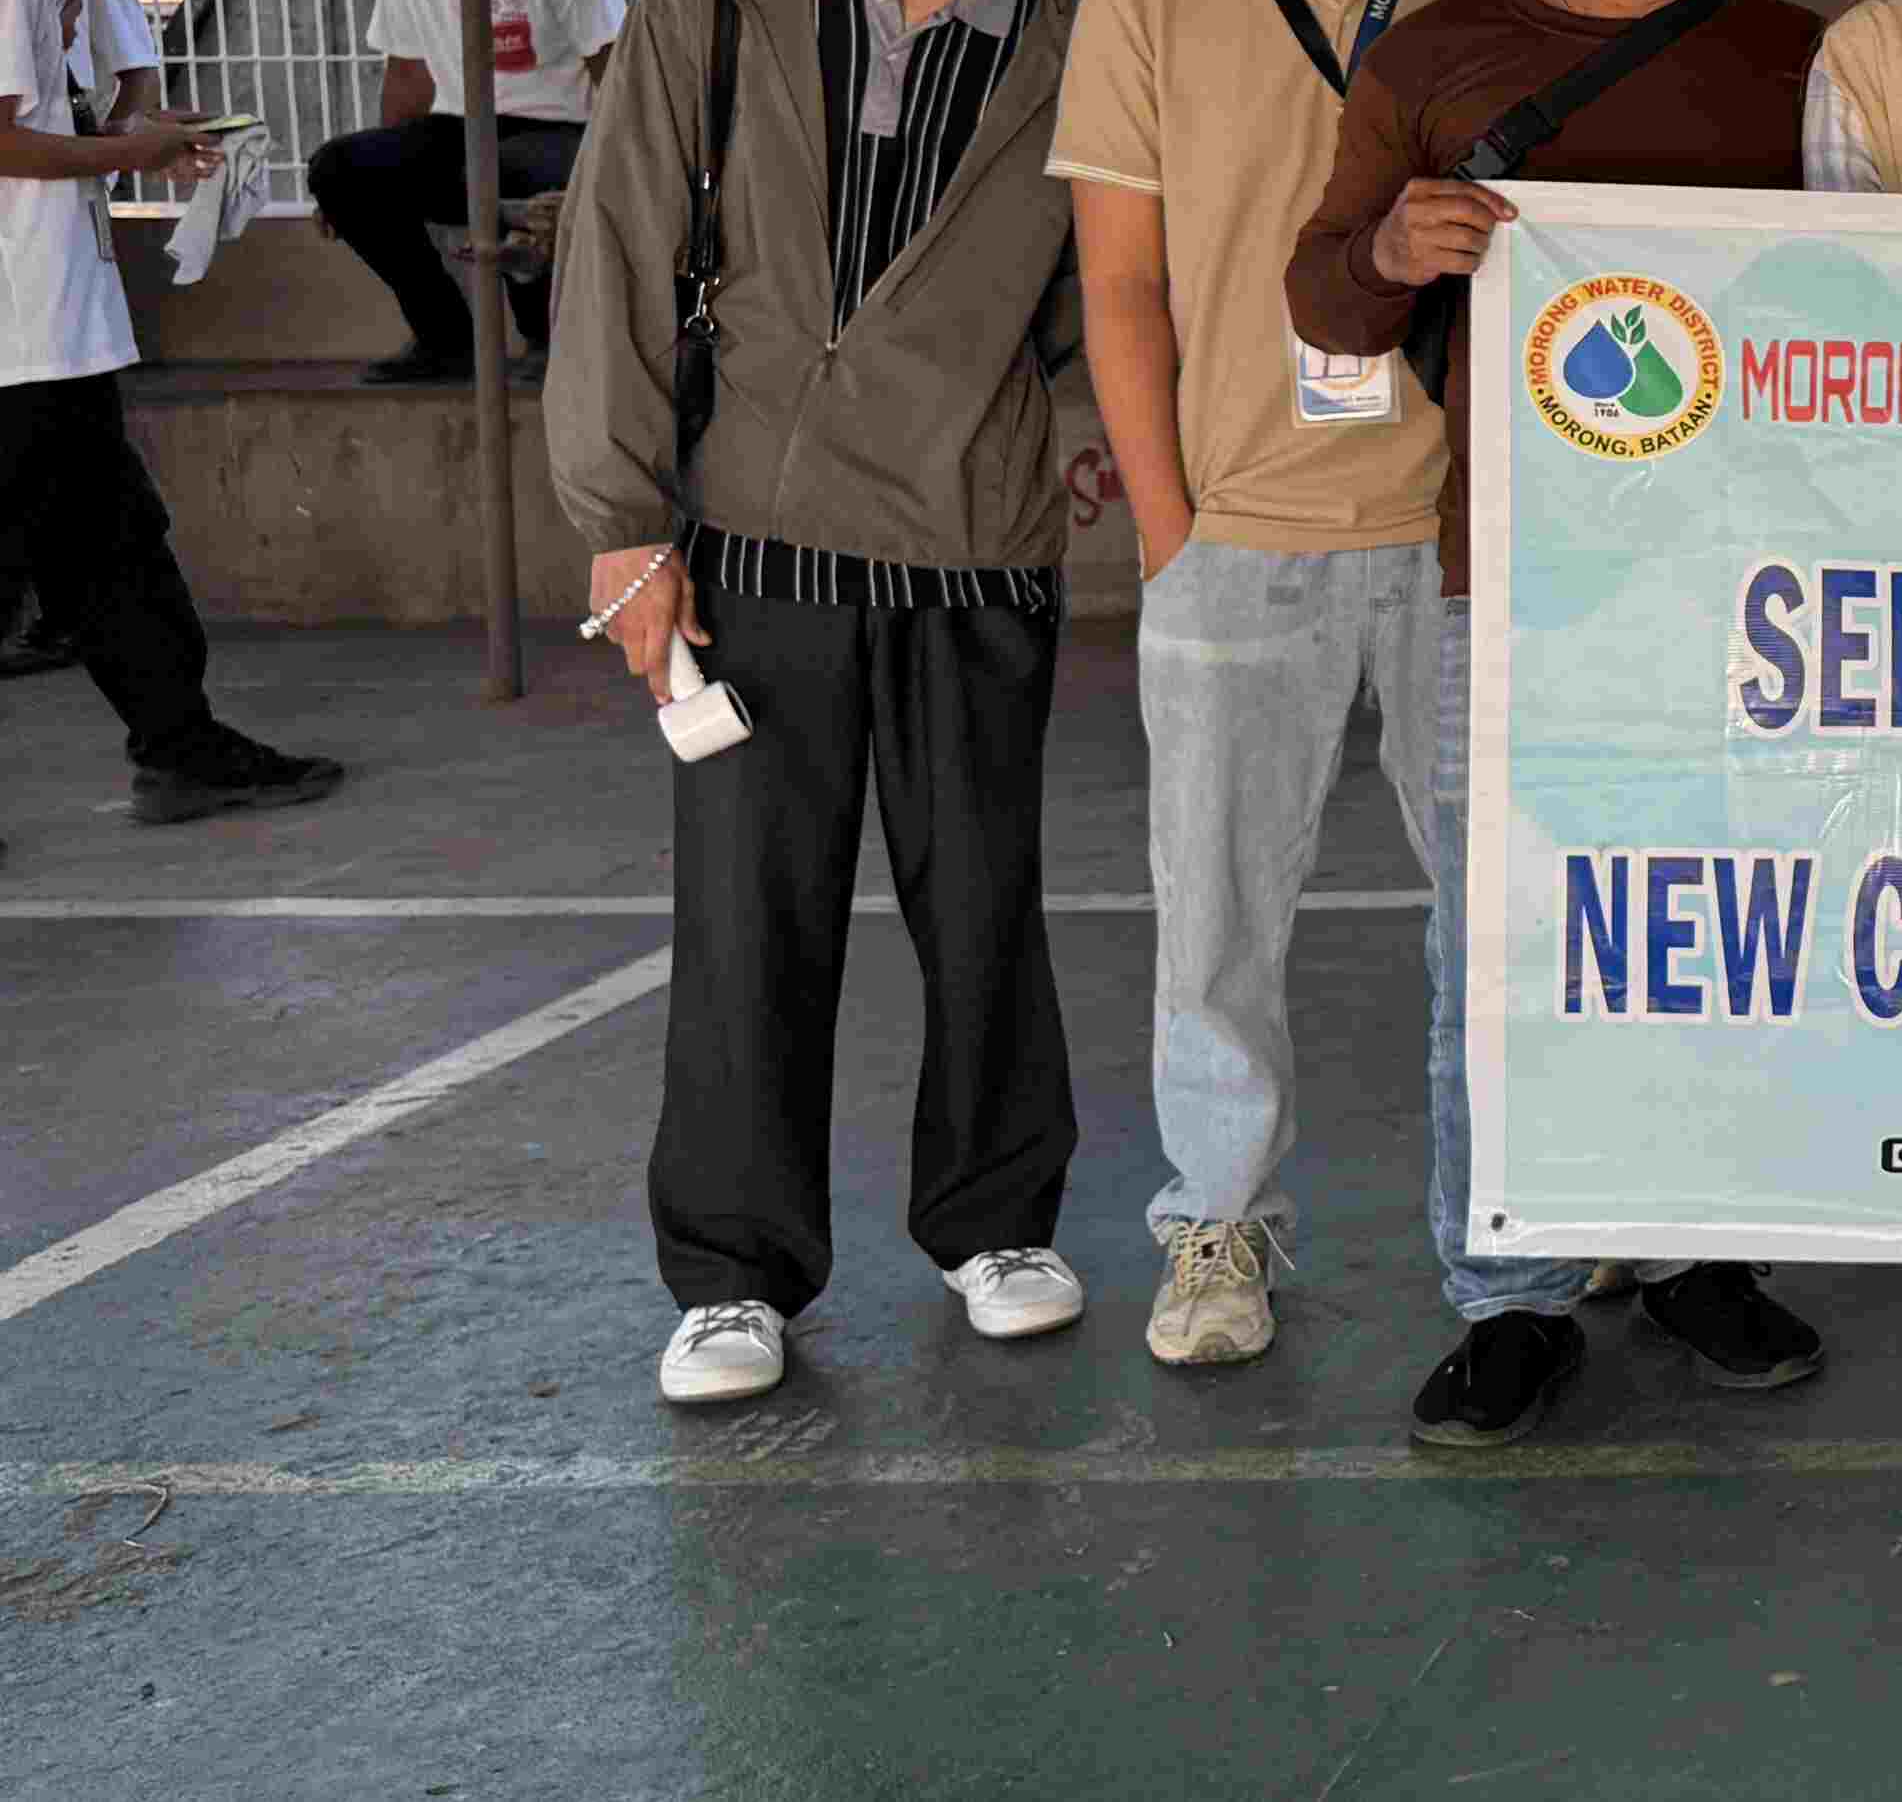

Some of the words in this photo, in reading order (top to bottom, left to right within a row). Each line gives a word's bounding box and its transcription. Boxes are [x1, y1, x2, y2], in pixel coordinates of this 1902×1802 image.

[1530, 294, 1578, 386] MORONG
[1583, 278, 1665, 302] WATER
[1669, 294, 1719, 390] DISTRICT
[1539, 396, 1635, 458] MORONG,
[1639, 398, 1713, 455] BATAAN
[1562, 854, 1814, 1018] NEW
